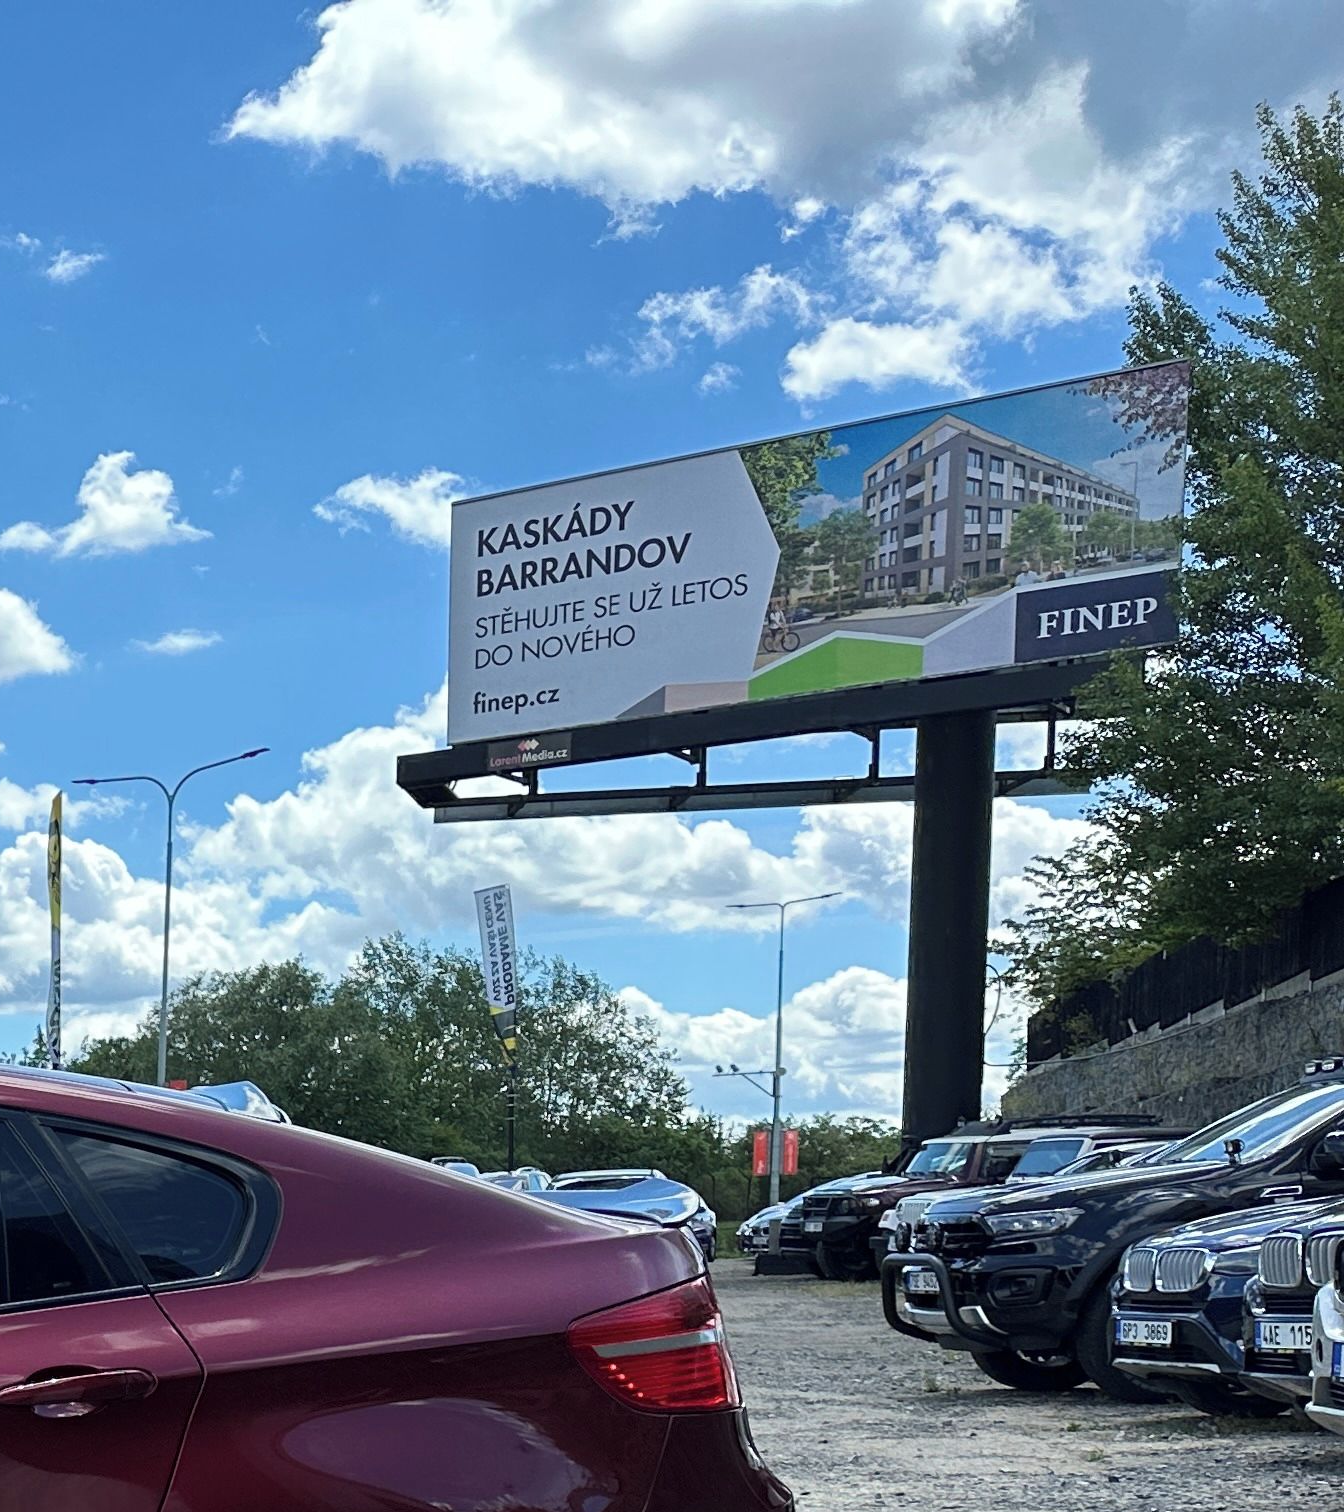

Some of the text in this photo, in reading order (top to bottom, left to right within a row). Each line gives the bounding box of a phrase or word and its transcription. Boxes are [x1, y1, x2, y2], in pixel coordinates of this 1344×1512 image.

[477, 500, 635, 558] KASKÁDY
[476, 532, 693, 598] BARRANDOV
[475, 573, 749, 639] STĚHUJTE SE UŽ LETOS
[1036, 597, 1158, 639] FINEP
[474, 624, 636, 670] DO NOVÉHO
[473, 688, 560, 715] finep.cz
[1144, 1323, 1168, 1341] 3869
[1290, 1325, 1313, 1346] 115
